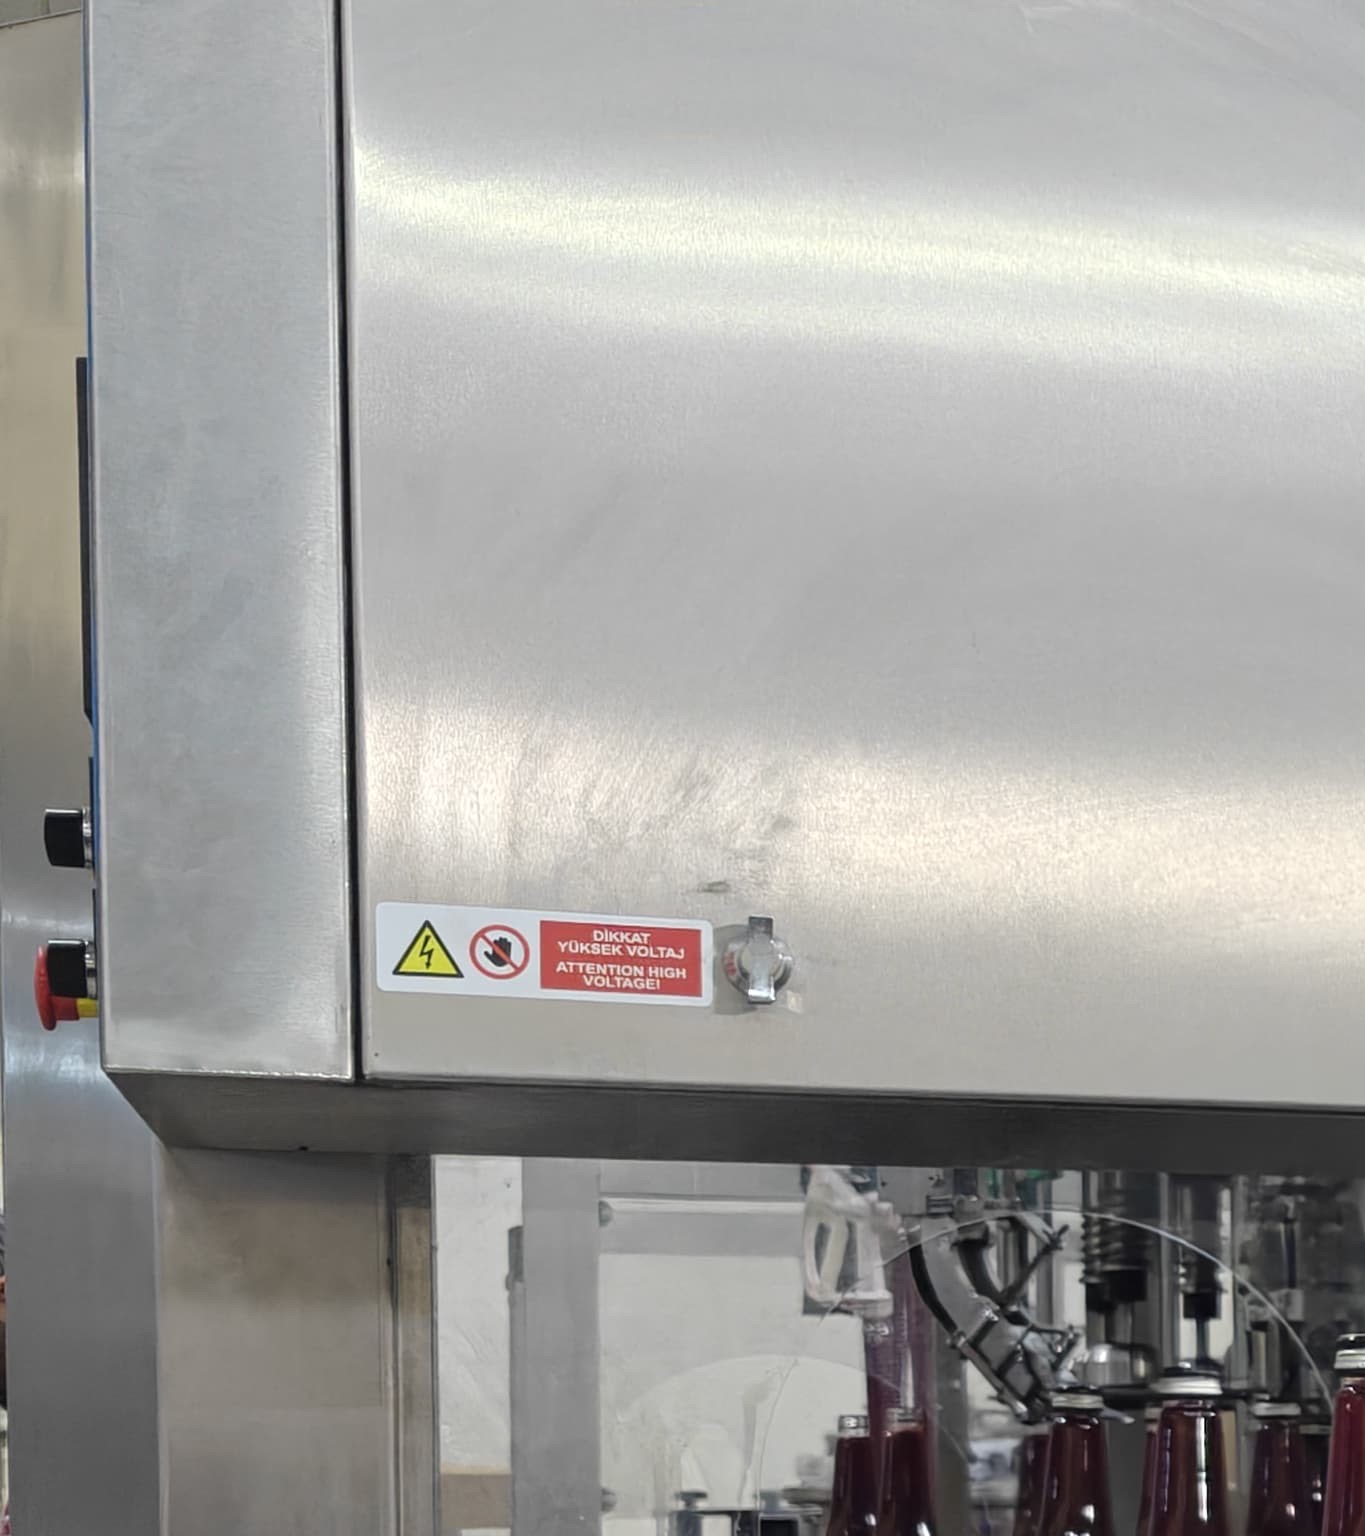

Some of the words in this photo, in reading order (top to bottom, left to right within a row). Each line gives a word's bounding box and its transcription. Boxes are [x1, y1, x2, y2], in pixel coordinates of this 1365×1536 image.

[592, 928, 651, 944] DİKKAT
[557, 940, 623, 956] YÜKSEK
[626, 945, 686, 960] VOLTAJ
[555, 961, 645, 977] ATTENTION
[649, 966, 687, 979] HIGH
